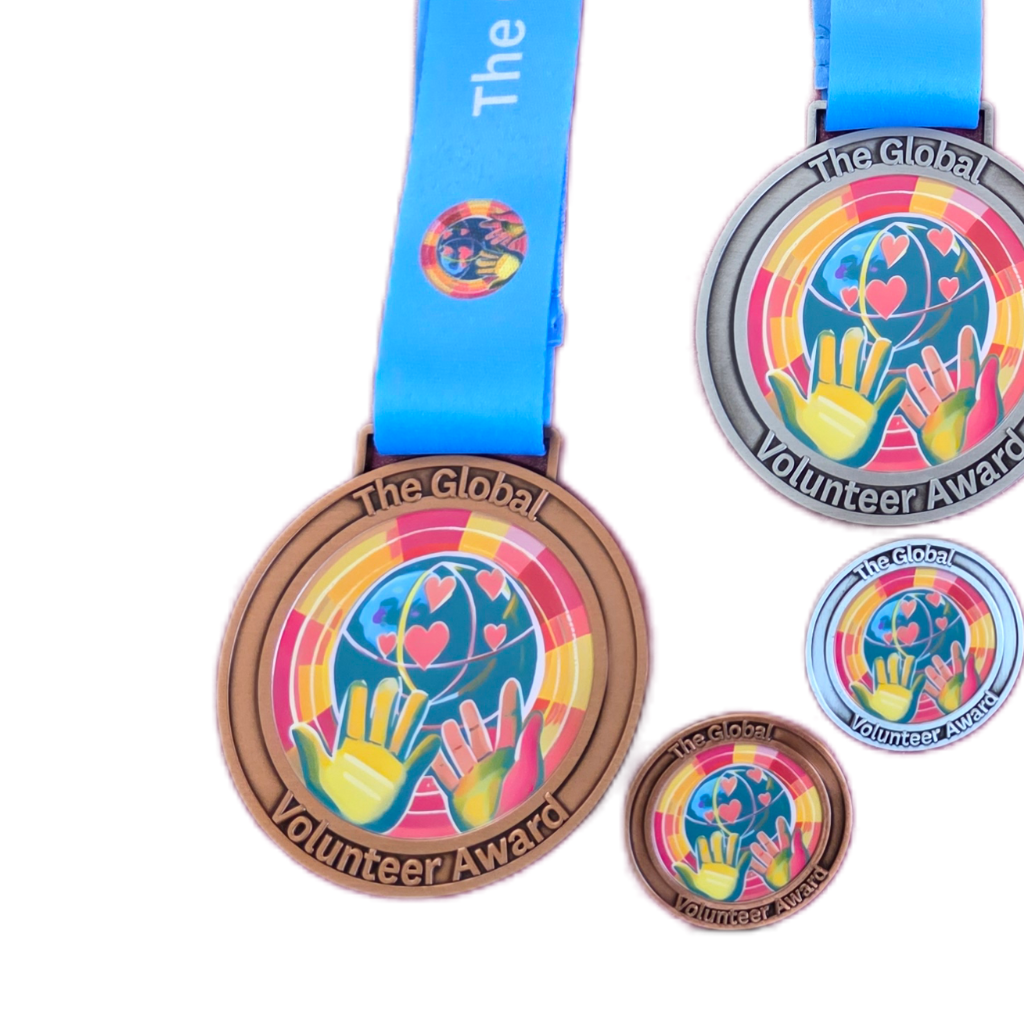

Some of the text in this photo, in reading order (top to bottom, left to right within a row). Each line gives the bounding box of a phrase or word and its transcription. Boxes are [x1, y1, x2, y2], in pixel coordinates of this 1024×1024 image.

[471, 18, 526, 117] The
[808, 137, 988, 185] The Global
[353, 466, 549, 522] The Global
[754, 430, 916, 514] Volunteer
[853, 544, 956, 582] The Global
[668, 720, 775, 759] The Global
[850, 690, 999, 746] Volunteer Award
[267, 790, 572, 886] Volunteer Award
[674, 866, 829, 925] Volunteer Award
